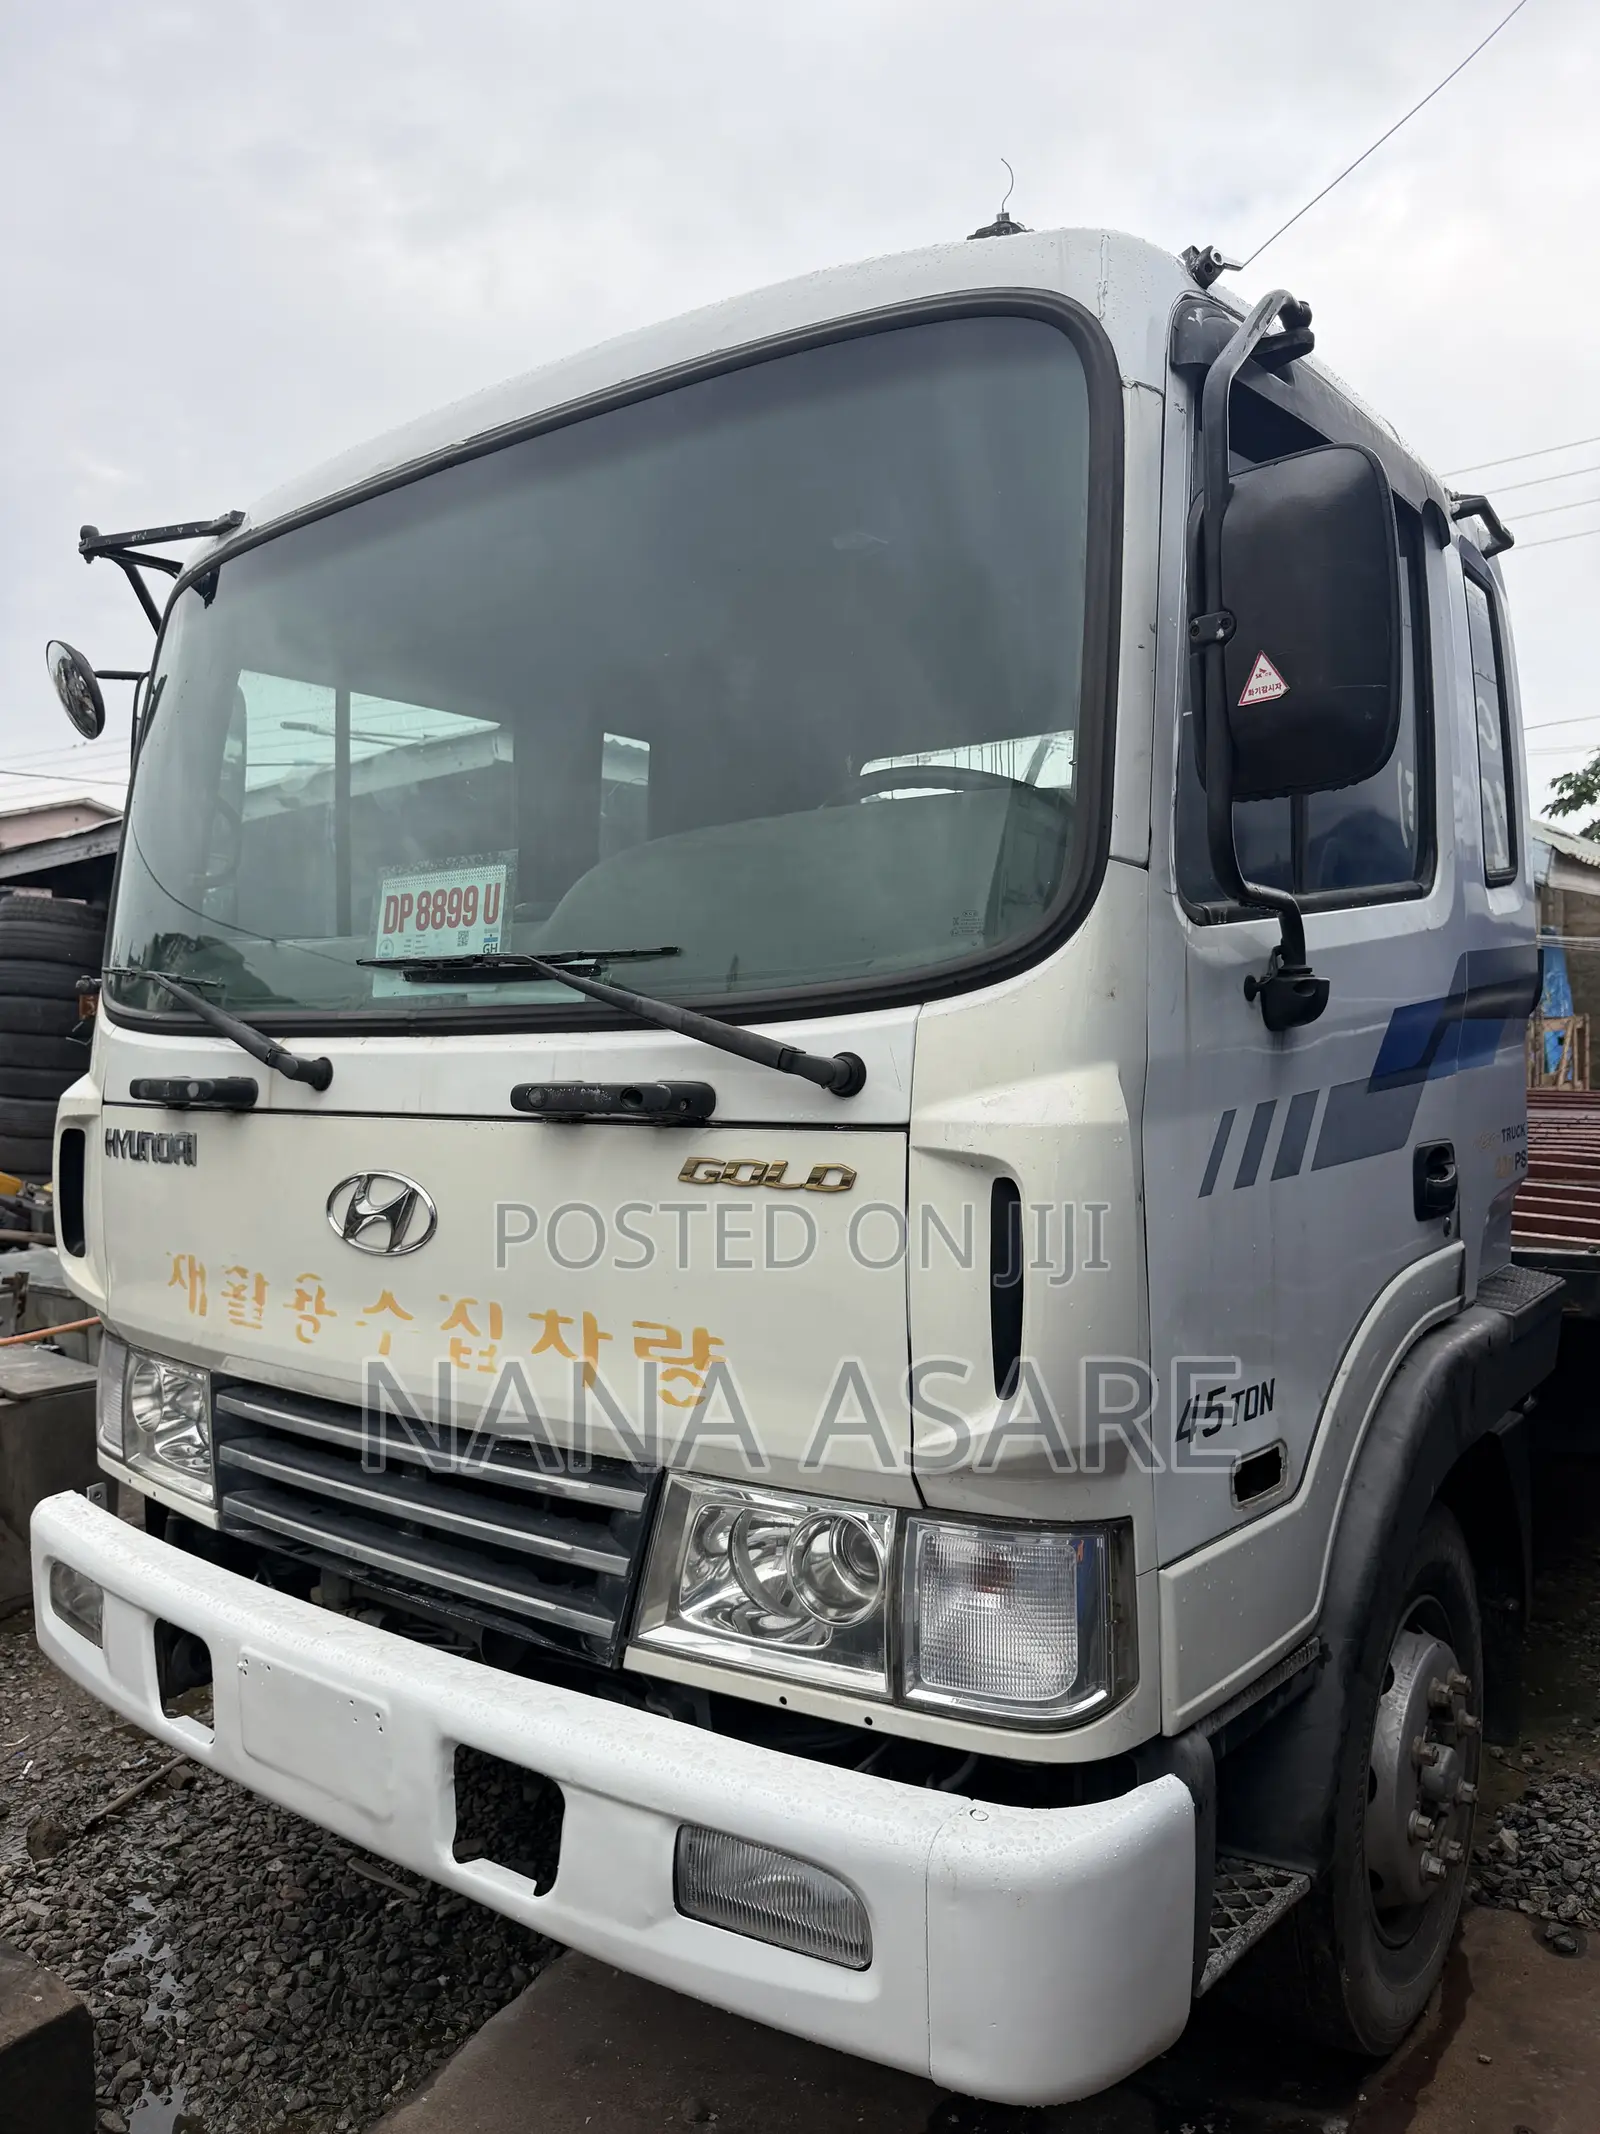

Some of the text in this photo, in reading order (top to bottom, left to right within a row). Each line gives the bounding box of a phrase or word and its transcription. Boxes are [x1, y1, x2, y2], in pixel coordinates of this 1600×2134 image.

[383, 883, 501, 934] DP 8899 U
[482, 942, 498, 954] GH
[104, 1127, 198, 1167] HYUNDAI
[1501, 1123, 1527, 1144] TRUCK
[677, 1156, 858, 1193] GOLD
[1514, 1150, 1527, 1171] PS
[1230, 1377, 1276, 1427] TON
